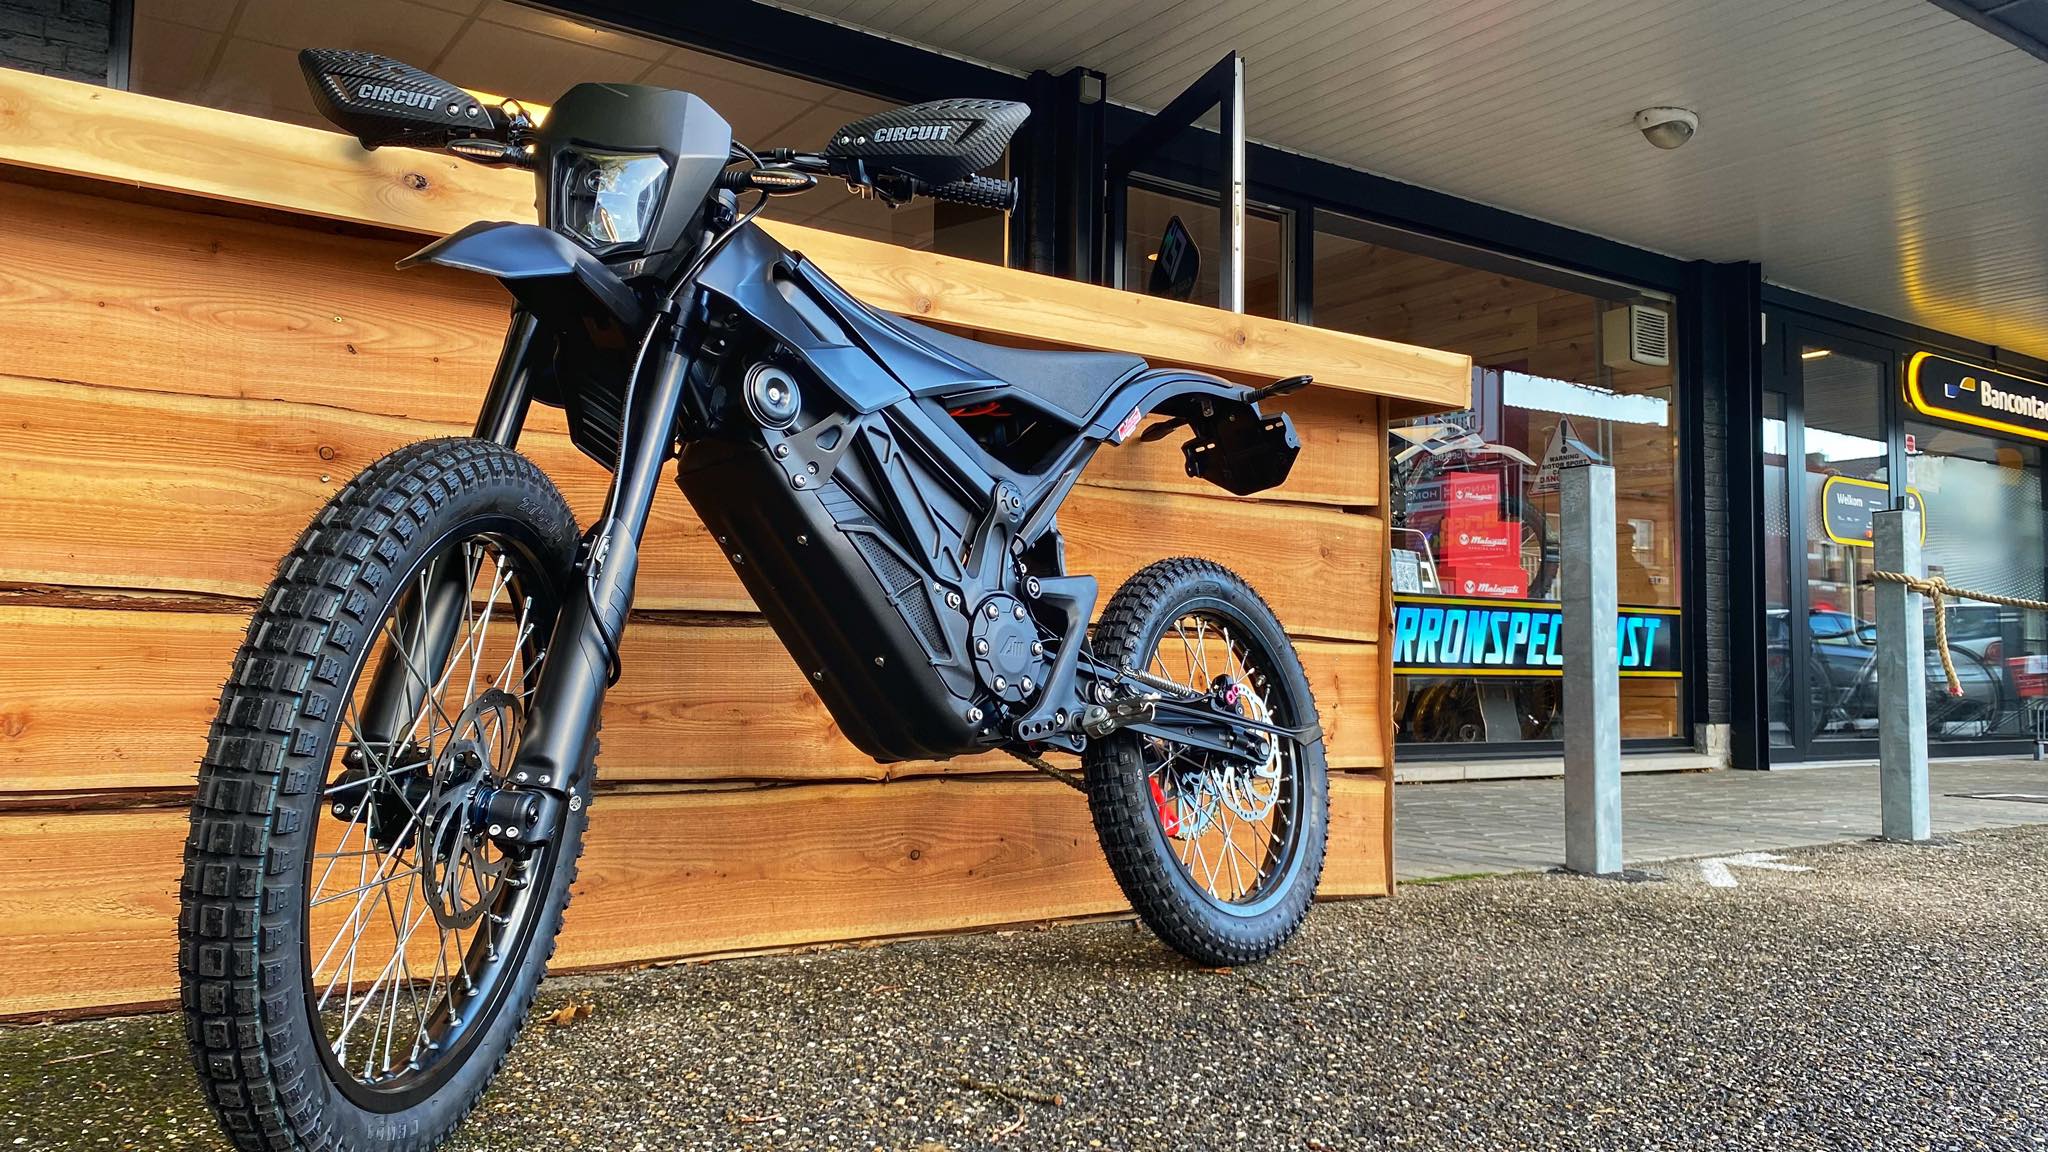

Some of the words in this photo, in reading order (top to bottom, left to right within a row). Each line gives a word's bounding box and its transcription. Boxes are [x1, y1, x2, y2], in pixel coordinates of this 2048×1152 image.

[358, 83, 442, 110] CIRCUIT
[873, 125, 952, 143] CIRCUIT
[1549, 453, 1580, 462] WARNING
[1541, 461, 1565, 470] MOTOR
[1836, 493, 1863, 507] Welkom
[1477, 583, 1519, 596] Malaguti
